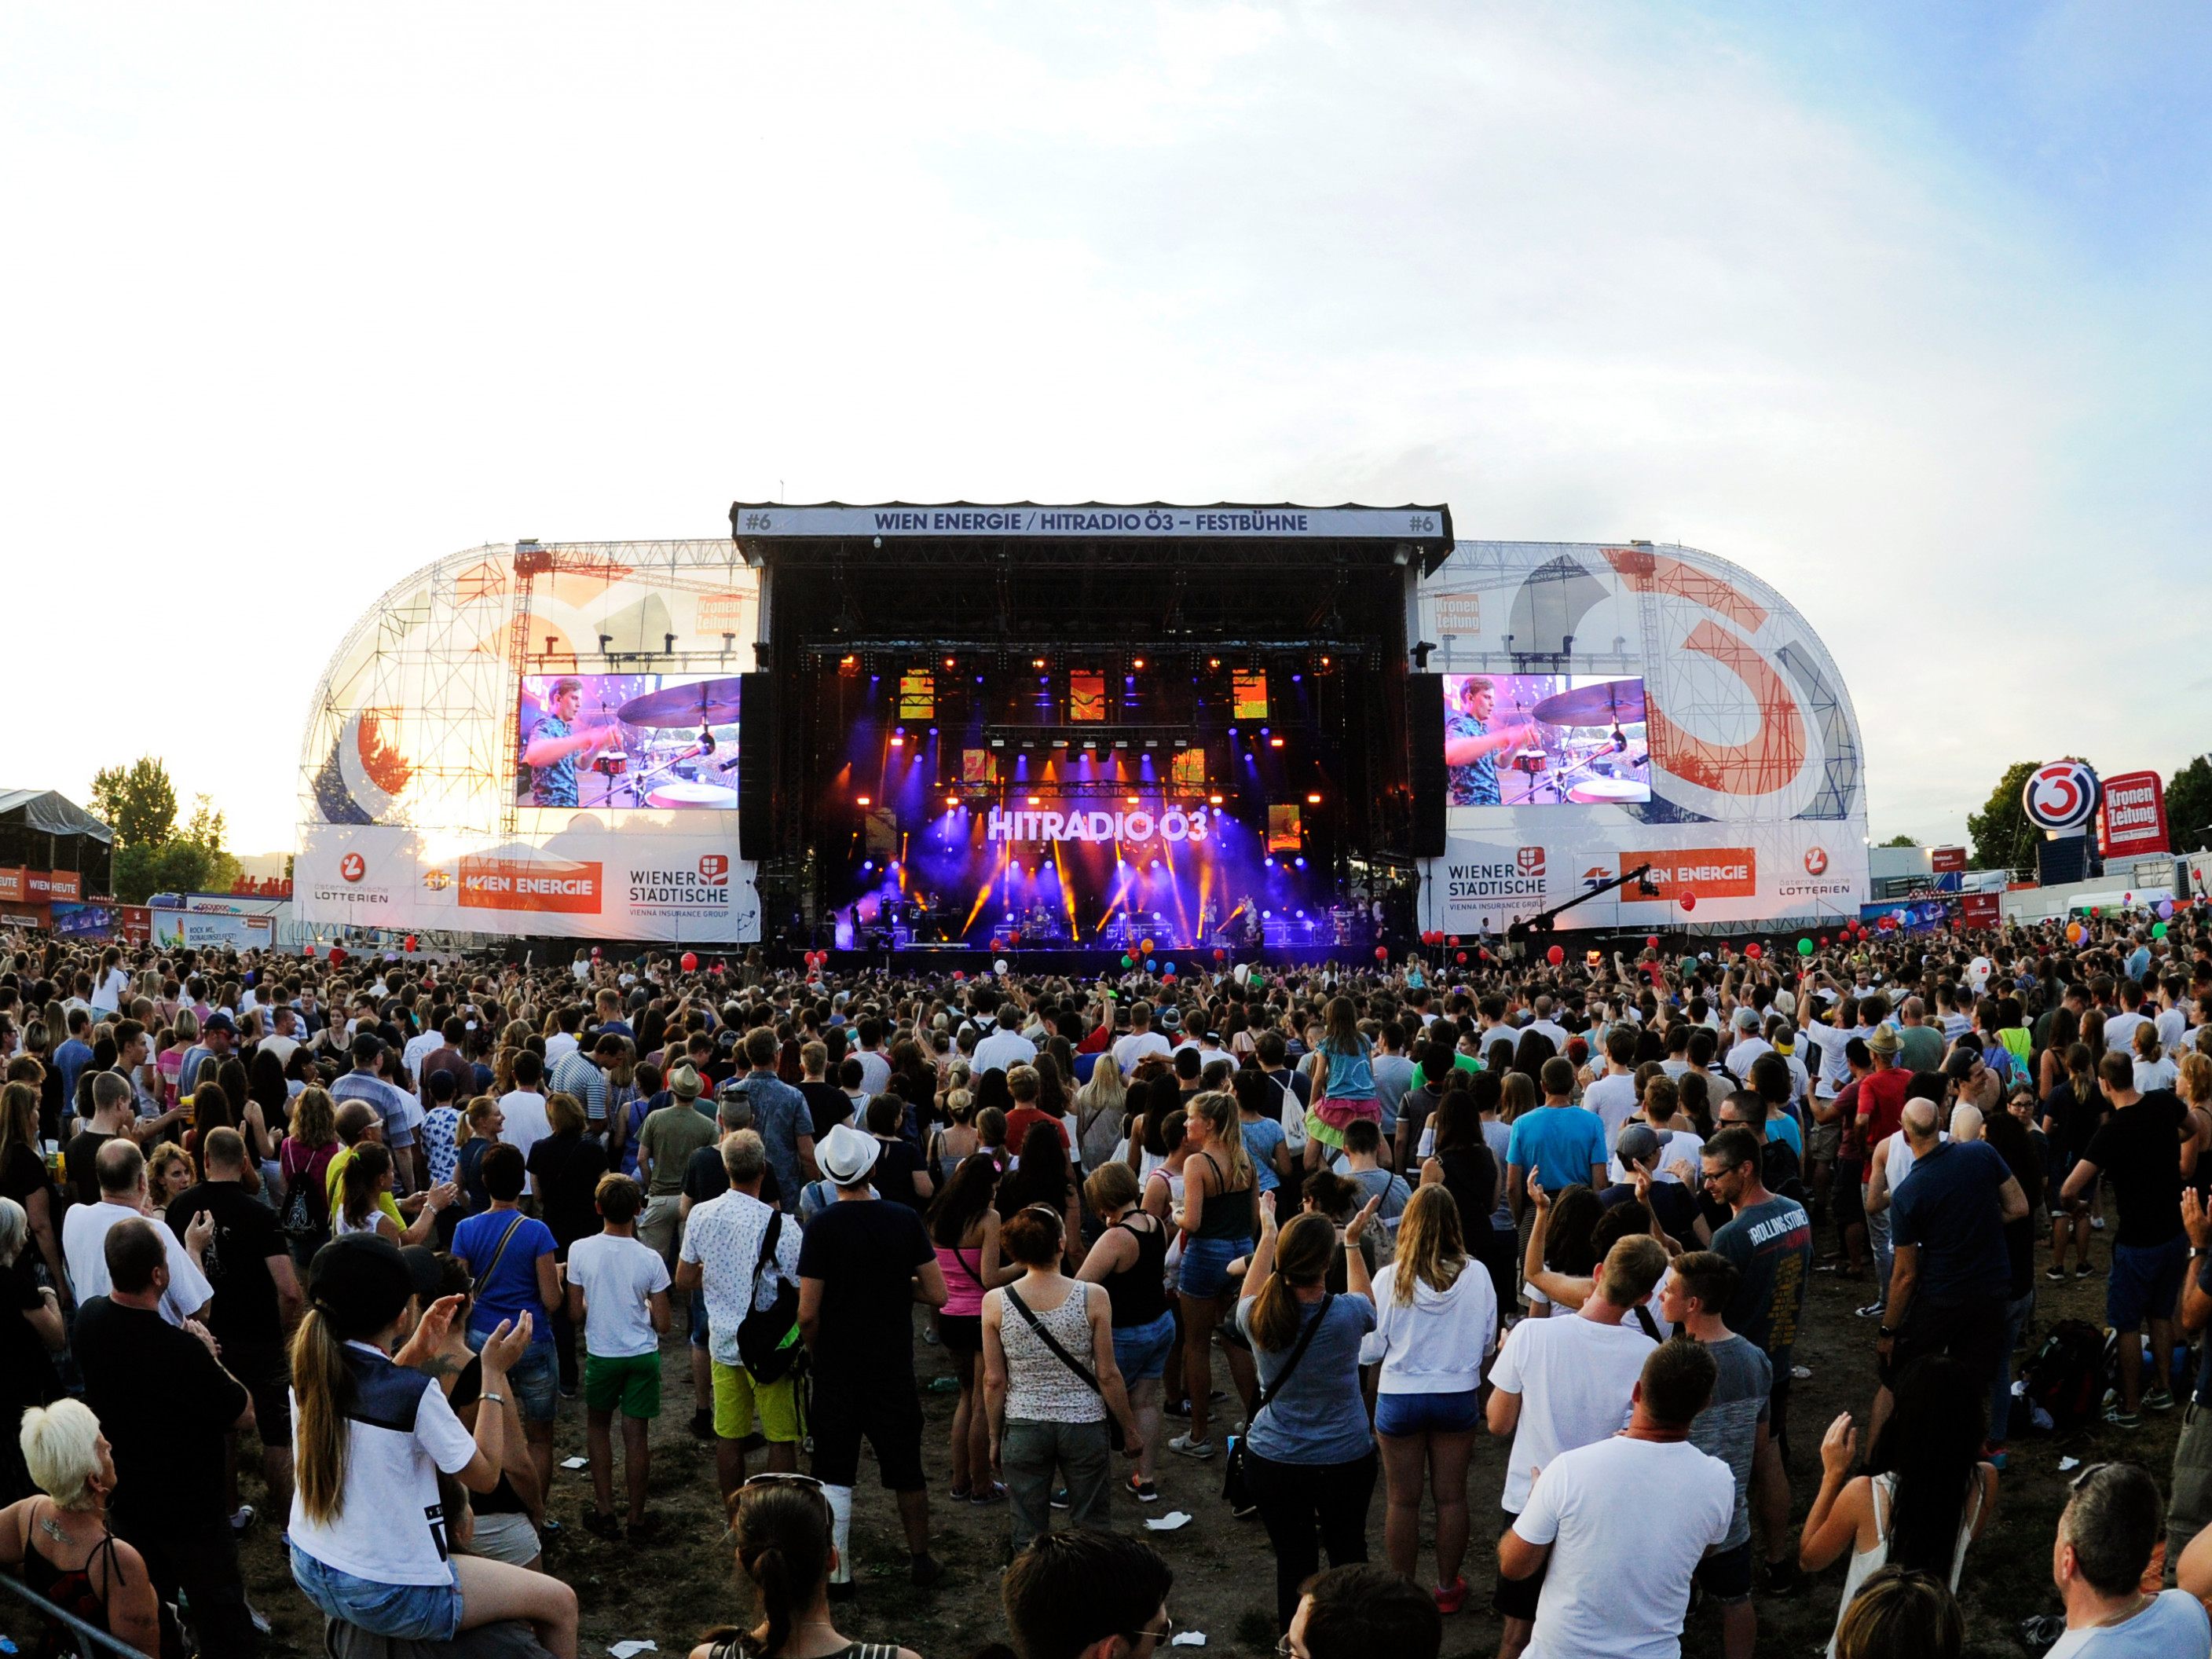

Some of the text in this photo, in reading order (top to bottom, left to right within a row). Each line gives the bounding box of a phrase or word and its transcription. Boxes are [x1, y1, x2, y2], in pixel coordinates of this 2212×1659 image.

[745, 513, 771, 530] #6
[874, 513, 928, 530] WIEN
[934, 513, 1021, 530] ENERGIE
[1041, 513, 1141, 530] HITRADIO
[1144, 510, 1174, 531] Ö3
[1196, 511, 1308, 531] FESTBÜHNE
[1409, 515, 1434, 533] #6
[1435, 597, 1478, 613] Kronen
[1436, 613, 1480, 630] Zeitung
[2107, 787, 2153, 808] Kronen
[2109, 806, 2155, 827] Zeitung
[987, 811, 1155, 842] HITRADIO
[630, 870, 696, 885] WIENER
[1448, 864, 1515, 879] WIENER
[1678, 866, 1748, 882] ENERGIE
[29, 879, 76, 894] WIEN HEUTE
[466, 875, 592, 895] WIEN ENERGIE
[1449, 880, 1547, 895] STÄDTISCHE
[1779, 885, 1850, 895] LOTTERIEN
[314, 892, 388, 903] LOTTERIEN
[629, 887, 729, 903] STÄDTISCHE
[1479, 901, 1520, 910] INSURANCE
[1749, 1215, 1788, 1247] ROLLING
[1783, 1207, 1809, 1231] STONE
